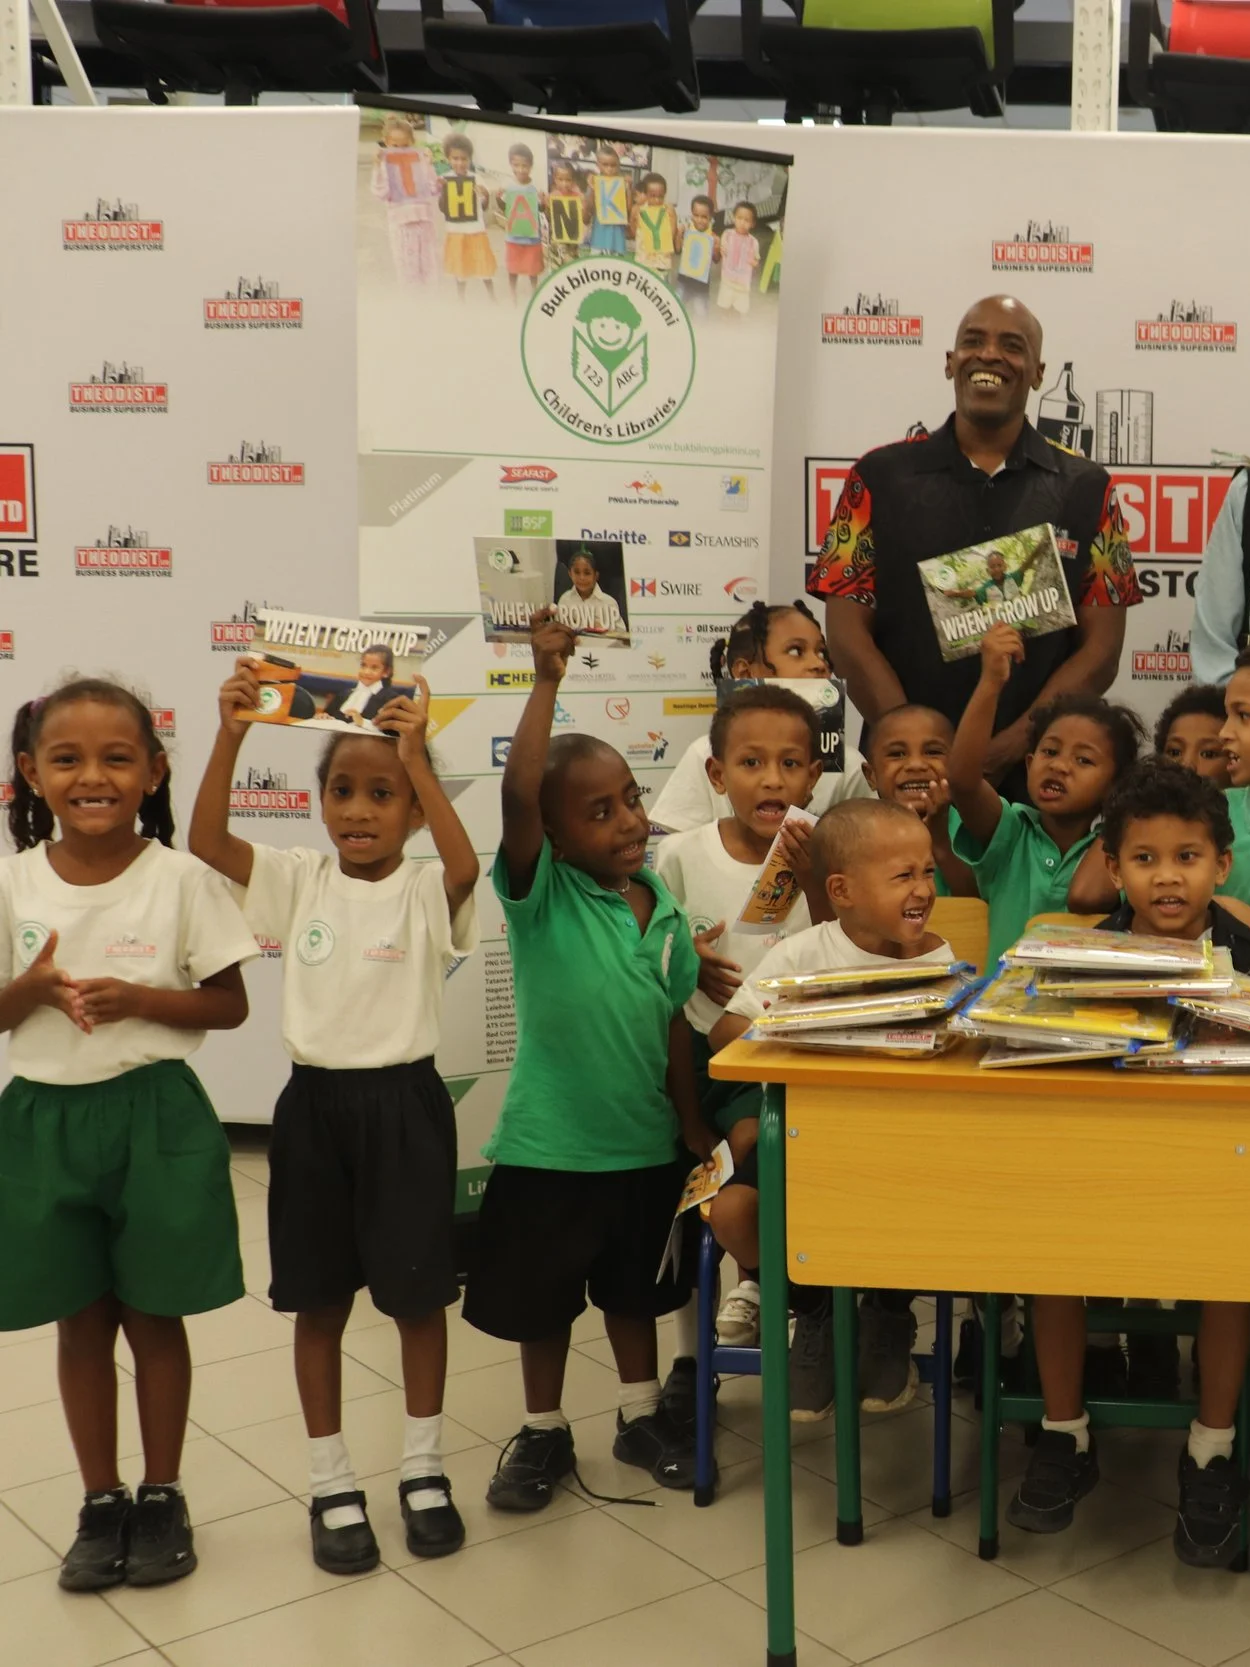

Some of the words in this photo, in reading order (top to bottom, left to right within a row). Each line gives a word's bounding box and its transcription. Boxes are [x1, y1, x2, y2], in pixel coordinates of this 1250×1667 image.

[995, 244, 1080, 261] THEODIST
[992, 264, 1035, 272] BUSINESS
[540, 282, 572, 318] Buk
[569, 267, 623, 288] bilong
[625, 270, 680, 327] Pikinini
[824, 317, 909, 335] THEODIST
[1138, 324, 1223, 341] THEODIST
[1180, 344, 1236, 352] SUPERSTORE
[582, 364, 604, 388] 123
[615, 364, 639, 389] ABC
[72, 387, 154, 402] THEODIST
[543, 388, 613, 437] Children's
[617, 396, 677, 437] Libraries
[210, 466, 291, 481] THEODIST
[511, 468, 550, 479] SEAFAST
[388, 470, 443, 518] Platinum
[0, 500, 23, 522] TD
[695, 532, 759, 548] STEAMSHIPS
[78, 551, 159, 566] THEODIST
[660, 580, 702, 596] SWIRE
[489, 600, 535, 625] WHEN
[559, 603, 596, 632] ROW
[598, 604, 621, 631] UP
[940, 612, 988, 641] WHEN
[1039, 587, 1059, 613] UP
[214, 625, 254, 641] THEO
[264, 619, 322, 648] WHEN
[322, 626, 332, 649] I
[334, 627, 392, 652] GROW
[392, 631, 418, 657] UP
[1135, 655, 1189, 669] THEOD
[820, 732, 839, 753] UP
[230, 793, 298, 808] HEODIST
[258, 811, 311, 819] SUPERSTORE
